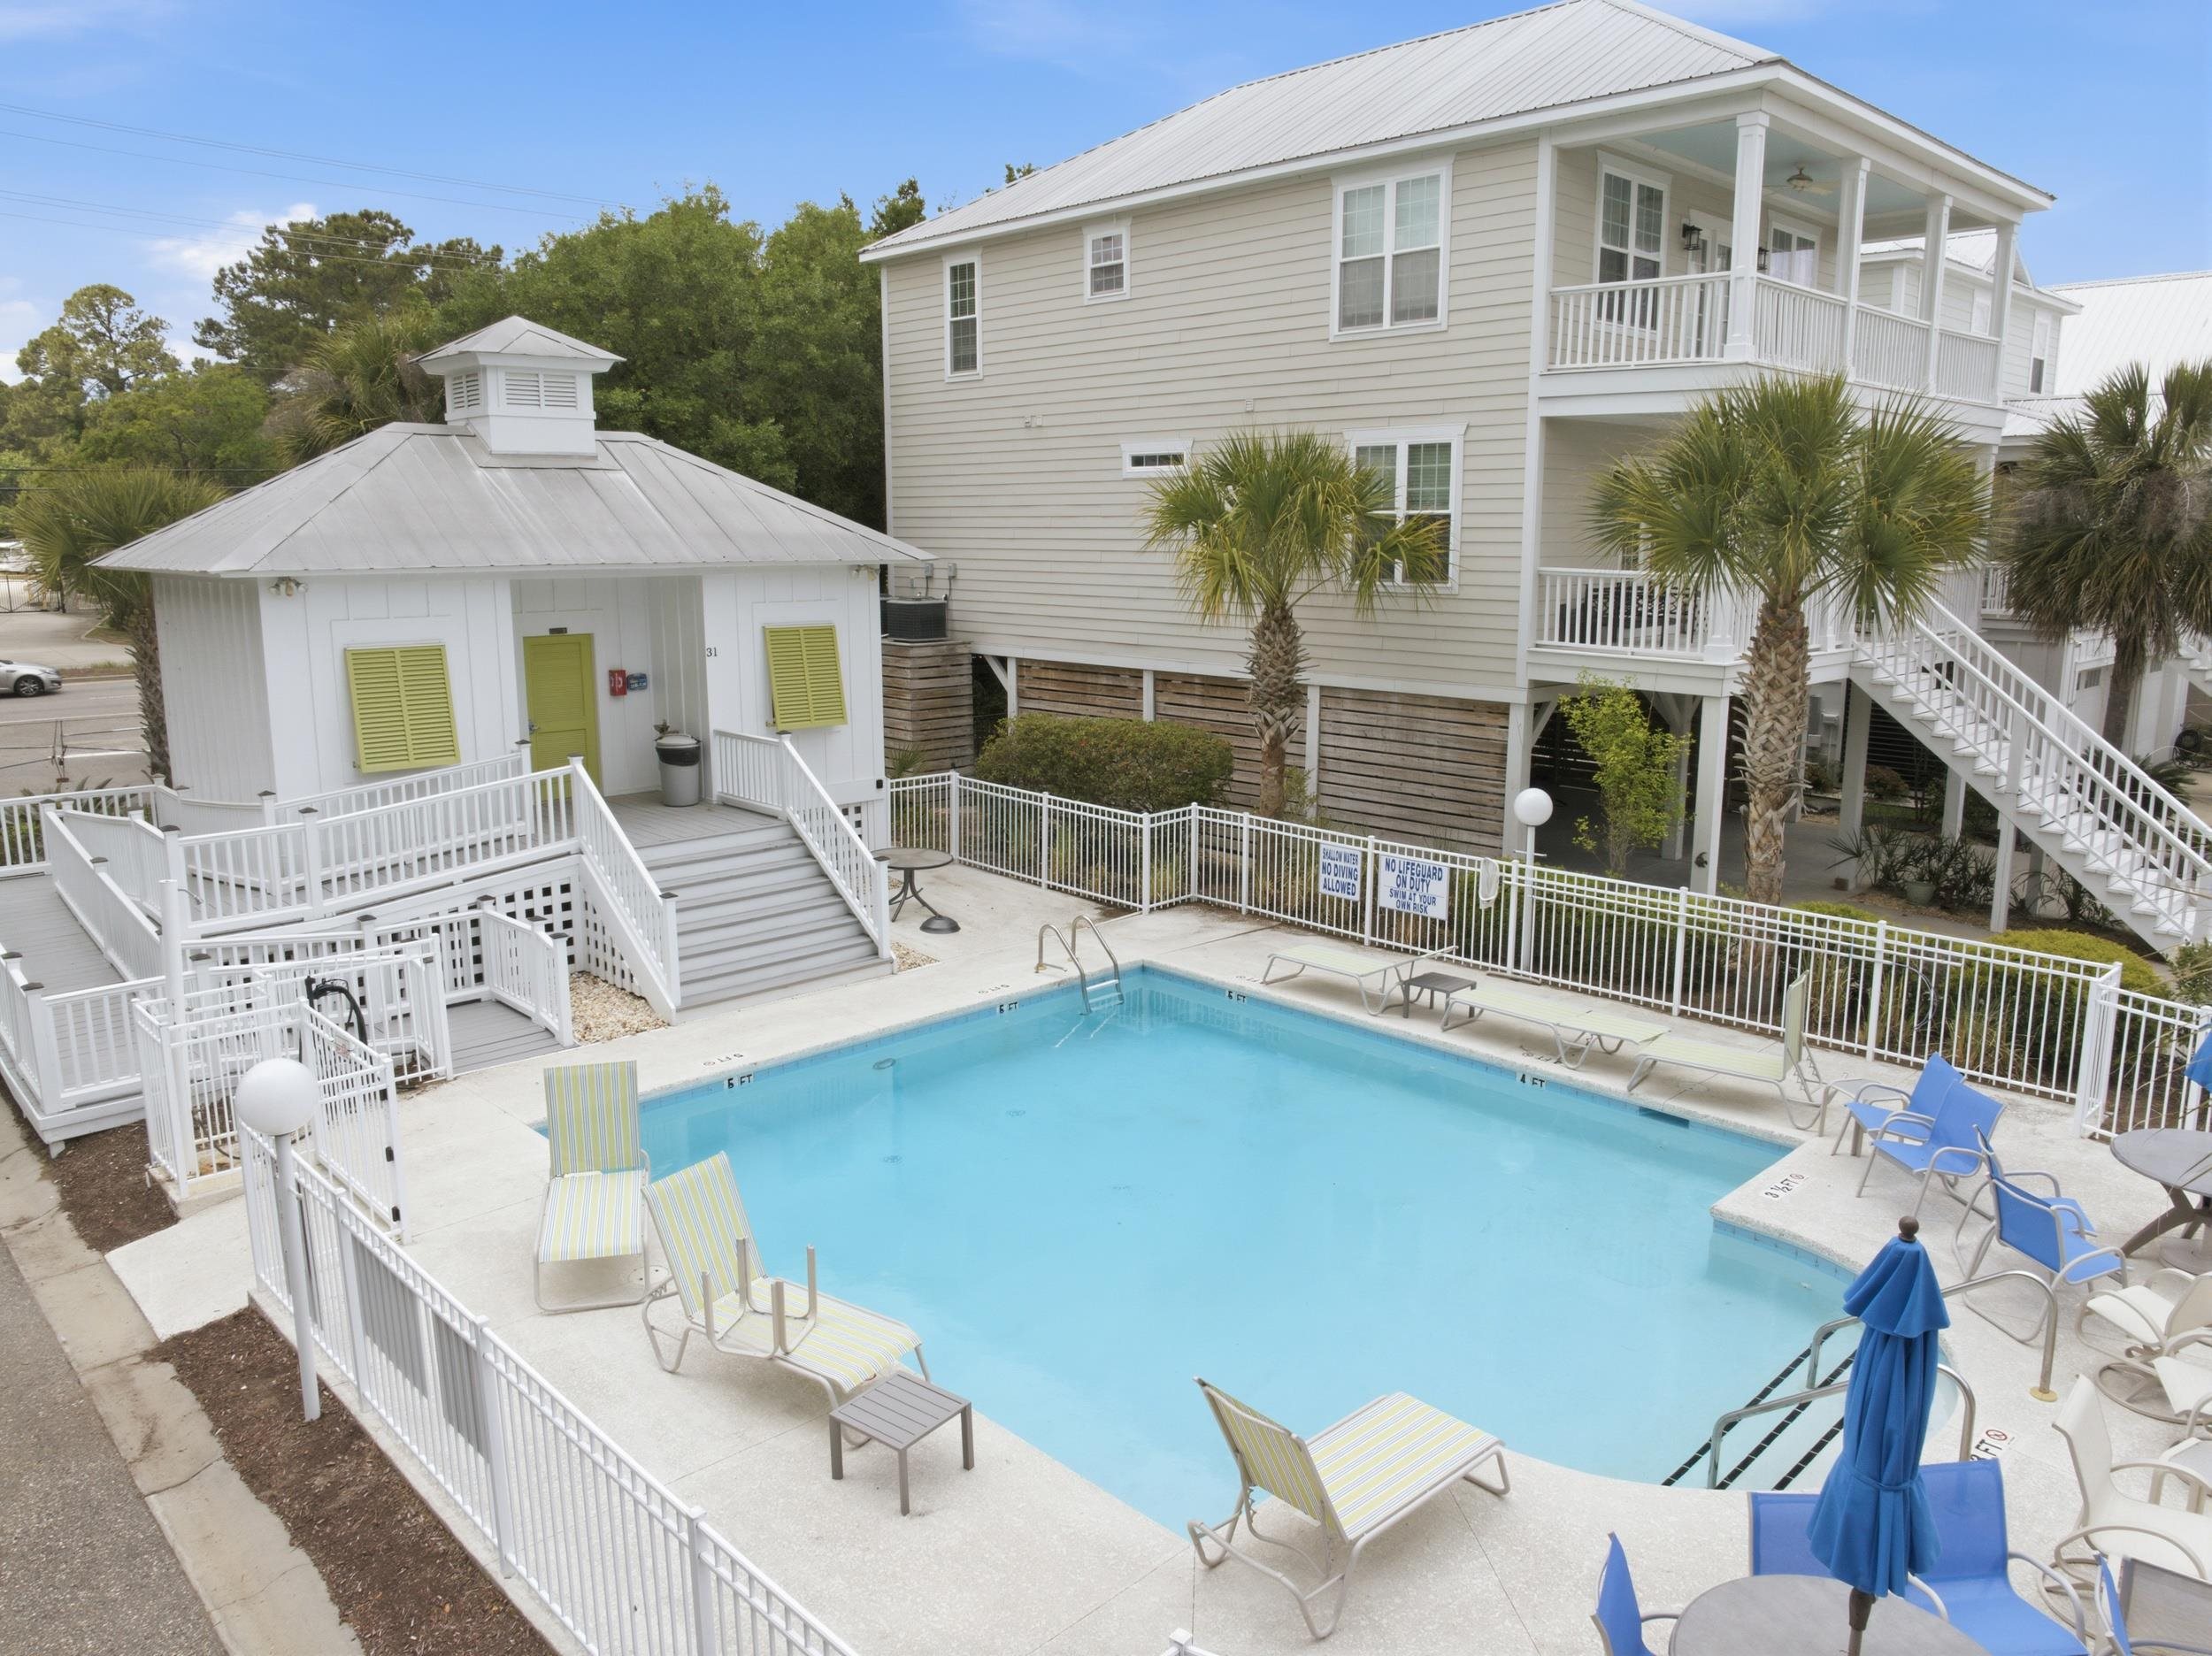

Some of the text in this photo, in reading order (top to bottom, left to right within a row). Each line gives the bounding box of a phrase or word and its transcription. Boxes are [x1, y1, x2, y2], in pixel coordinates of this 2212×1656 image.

[706, 647, 718, 657] 31
[1322, 847, 1359, 866] SHALLOW WATER
[1321, 861, 1358, 881] NO DIVING
[1385, 857, 1443, 881] NO LIFEGUARD
[1323, 877, 1356, 896] ALLOWED
[1395, 874, 1431, 893] ON DUTY
[1389, 888, 1437, 907] SWIM AT YOUR
[1395, 899, 1428, 915] OWN RISK
[740, 1074, 753, 1086] FT
[1520, 1073, 1546, 1088] 4 FT
[1975, 1439, 2002, 1457] FT
